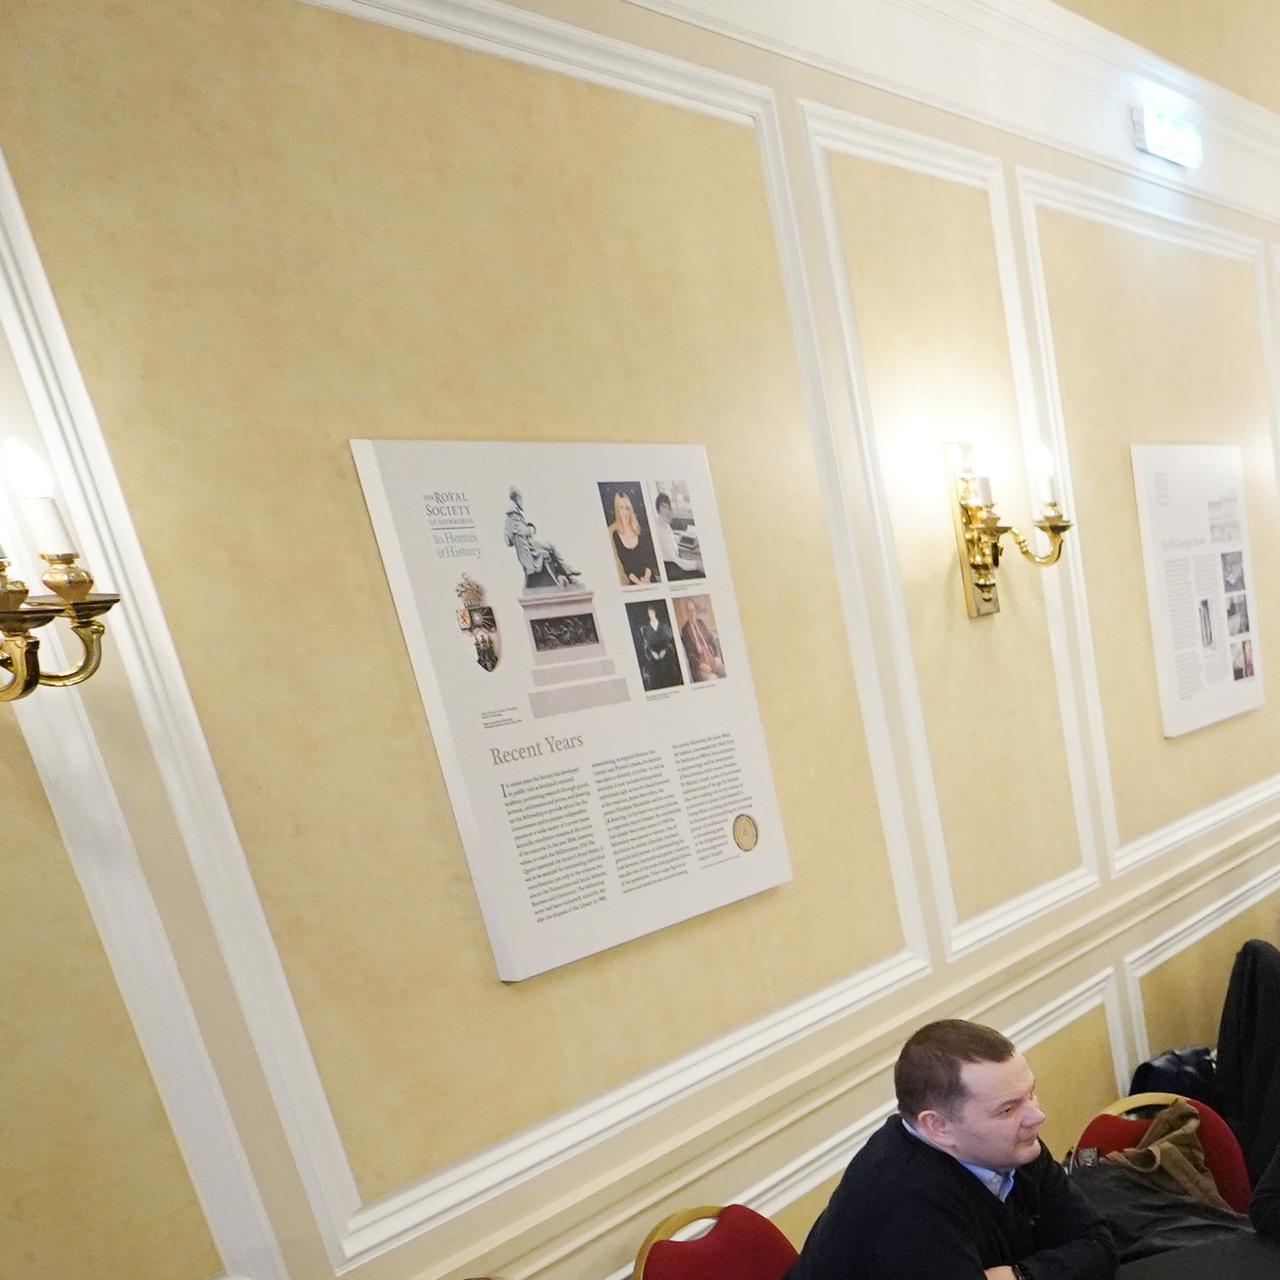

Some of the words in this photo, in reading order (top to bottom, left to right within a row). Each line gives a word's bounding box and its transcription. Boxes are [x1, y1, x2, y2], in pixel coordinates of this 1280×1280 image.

[433, 491, 469, 504] ROYAL
[425, 504, 471, 517] SOCIETY
[489, 741, 543, 766] Recent
[544, 734, 584, 754] Years
